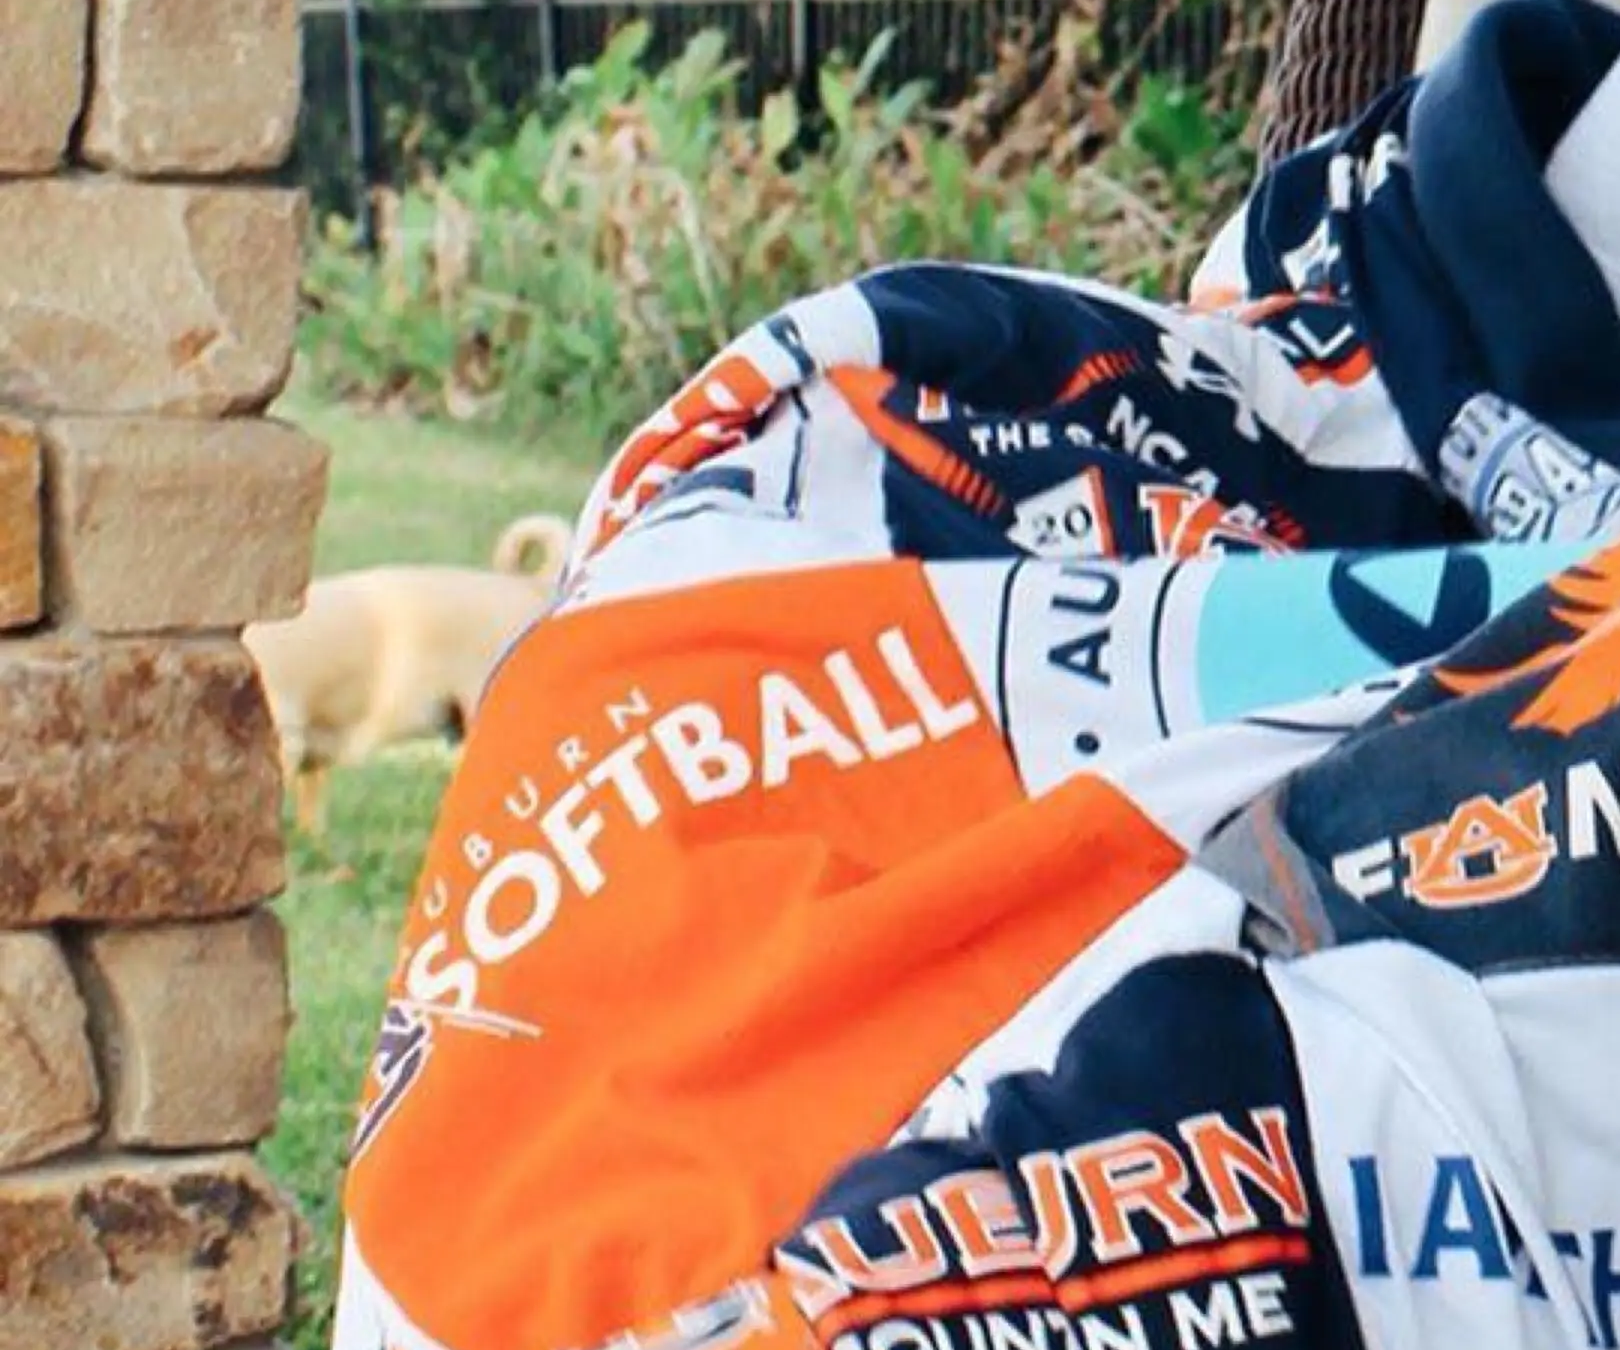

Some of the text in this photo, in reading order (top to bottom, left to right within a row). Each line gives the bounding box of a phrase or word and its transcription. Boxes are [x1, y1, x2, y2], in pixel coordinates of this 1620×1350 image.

[968, 421, 1052, 457] THE
[400, 686, 652, 962] UBURN
[406, 626, 979, 1017] SOFTBALL
